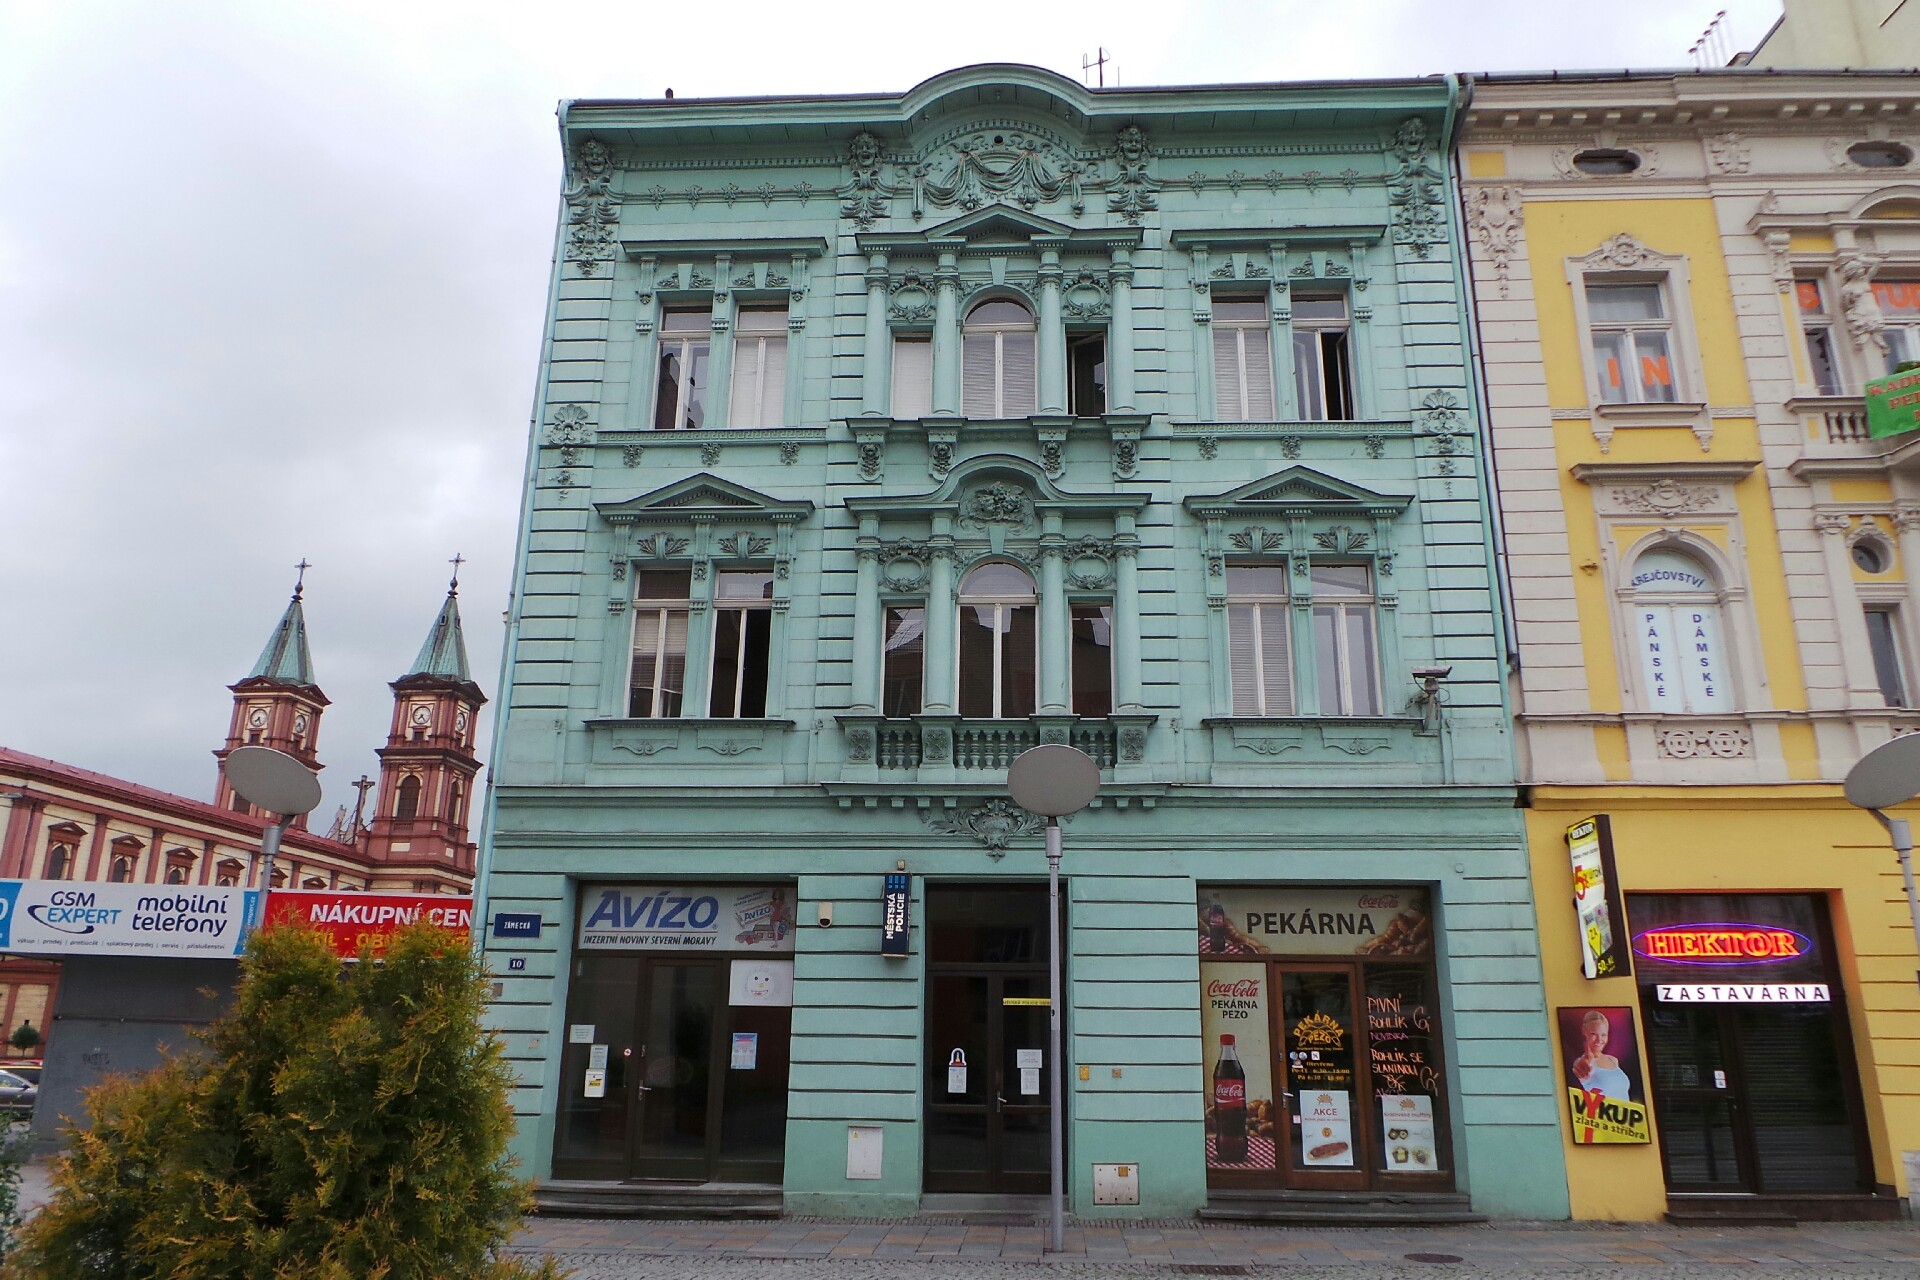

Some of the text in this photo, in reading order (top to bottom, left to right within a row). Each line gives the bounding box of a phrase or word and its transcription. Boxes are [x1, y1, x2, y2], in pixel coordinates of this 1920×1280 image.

[1645, 613, 1668, 698] PÁNSKÉ
[1692, 613, 1715, 698] DÁMSKÉ
[50, 890, 96, 908] GSM
[137, 894, 230, 915] mobilní
[46, 907, 122, 925] EXPERT
[310, 900, 423, 926] NÁKUPNÍ
[885, 893, 896, 940] MĚSTSKÁ
[895, 893, 905, 932] POLICIE
[1246, 908, 1376, 935] PEKÁRNA
[131, 912, 228, 938] telefony
[503, 920, 531, 930] ZÁMECKÁ
[583, 934, 718, 946] INZERTNÍ NOVINY SEVERNÍ MORAVY
[1644, 930, 1801, 957] HEKTOR
[511, 960, 523, 968] 10
[1207, 979, 1261, 998] Coca-Cola
[1662, 984, 1826, 1001] ZASTAVÁRNA
[1211, 998, 1258, 1010] PEKÁRNA
[1366, 993, 1402, 1013] PIVNÍ
[1222, 1010, 1249, 1019] PEZO
[1293, 1010, 1344, 1037] PEKÁRNA
[1369, 1013, 1408, 1029] ROHLÍK
[1308, 1030, 1331, 1044] PEZO
[1370, 1032, 1409, 1041] NOVINKA
[1370, 1048, 1424, 1063] ROHLÍK SE
[1371, 1063, 1418, 1076] SLANINOU
[1313, 1108, 1338, 1116] AKCE
[1573, 1088, 1644, 1128] VÝKUP
[1575, 1116, 1600, 1129] zlata
[1611, 1125, 1646, 1140] stříbra
